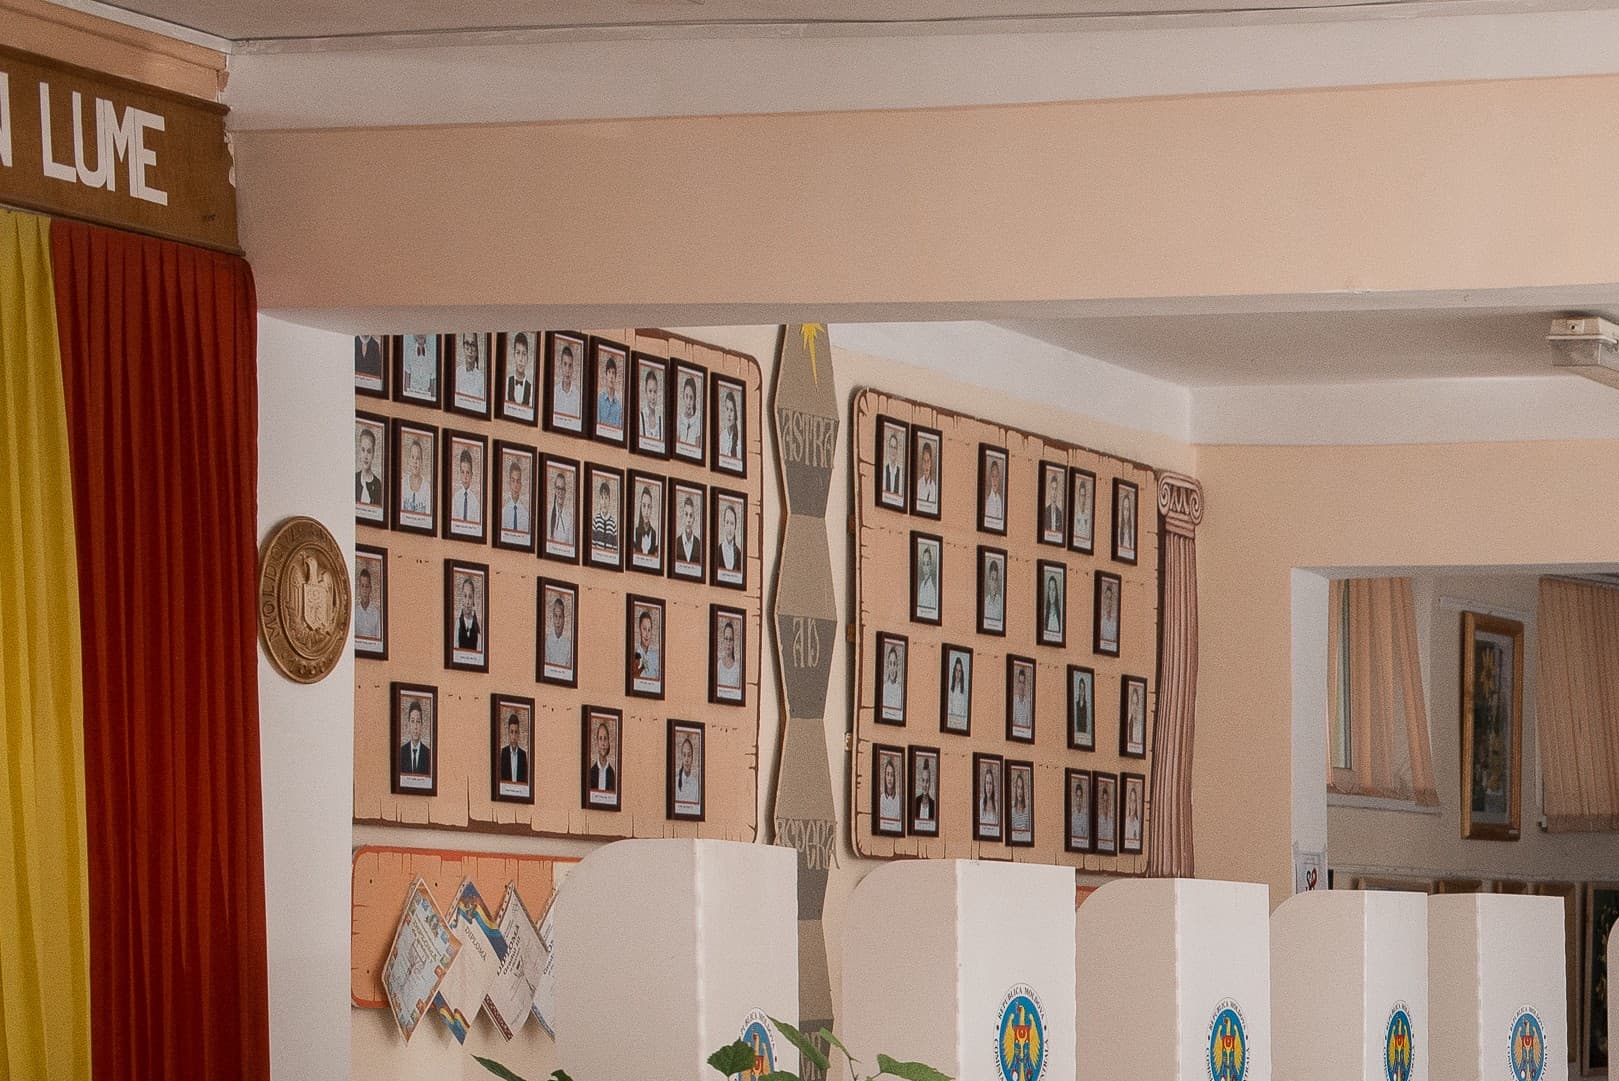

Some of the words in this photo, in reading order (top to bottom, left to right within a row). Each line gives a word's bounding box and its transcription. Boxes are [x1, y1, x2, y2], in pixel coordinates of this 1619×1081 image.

[39, 81, 168, 206] LUME
[782, 409, 836, 469] ASTRA
[792, 616, 820, 668] AD
